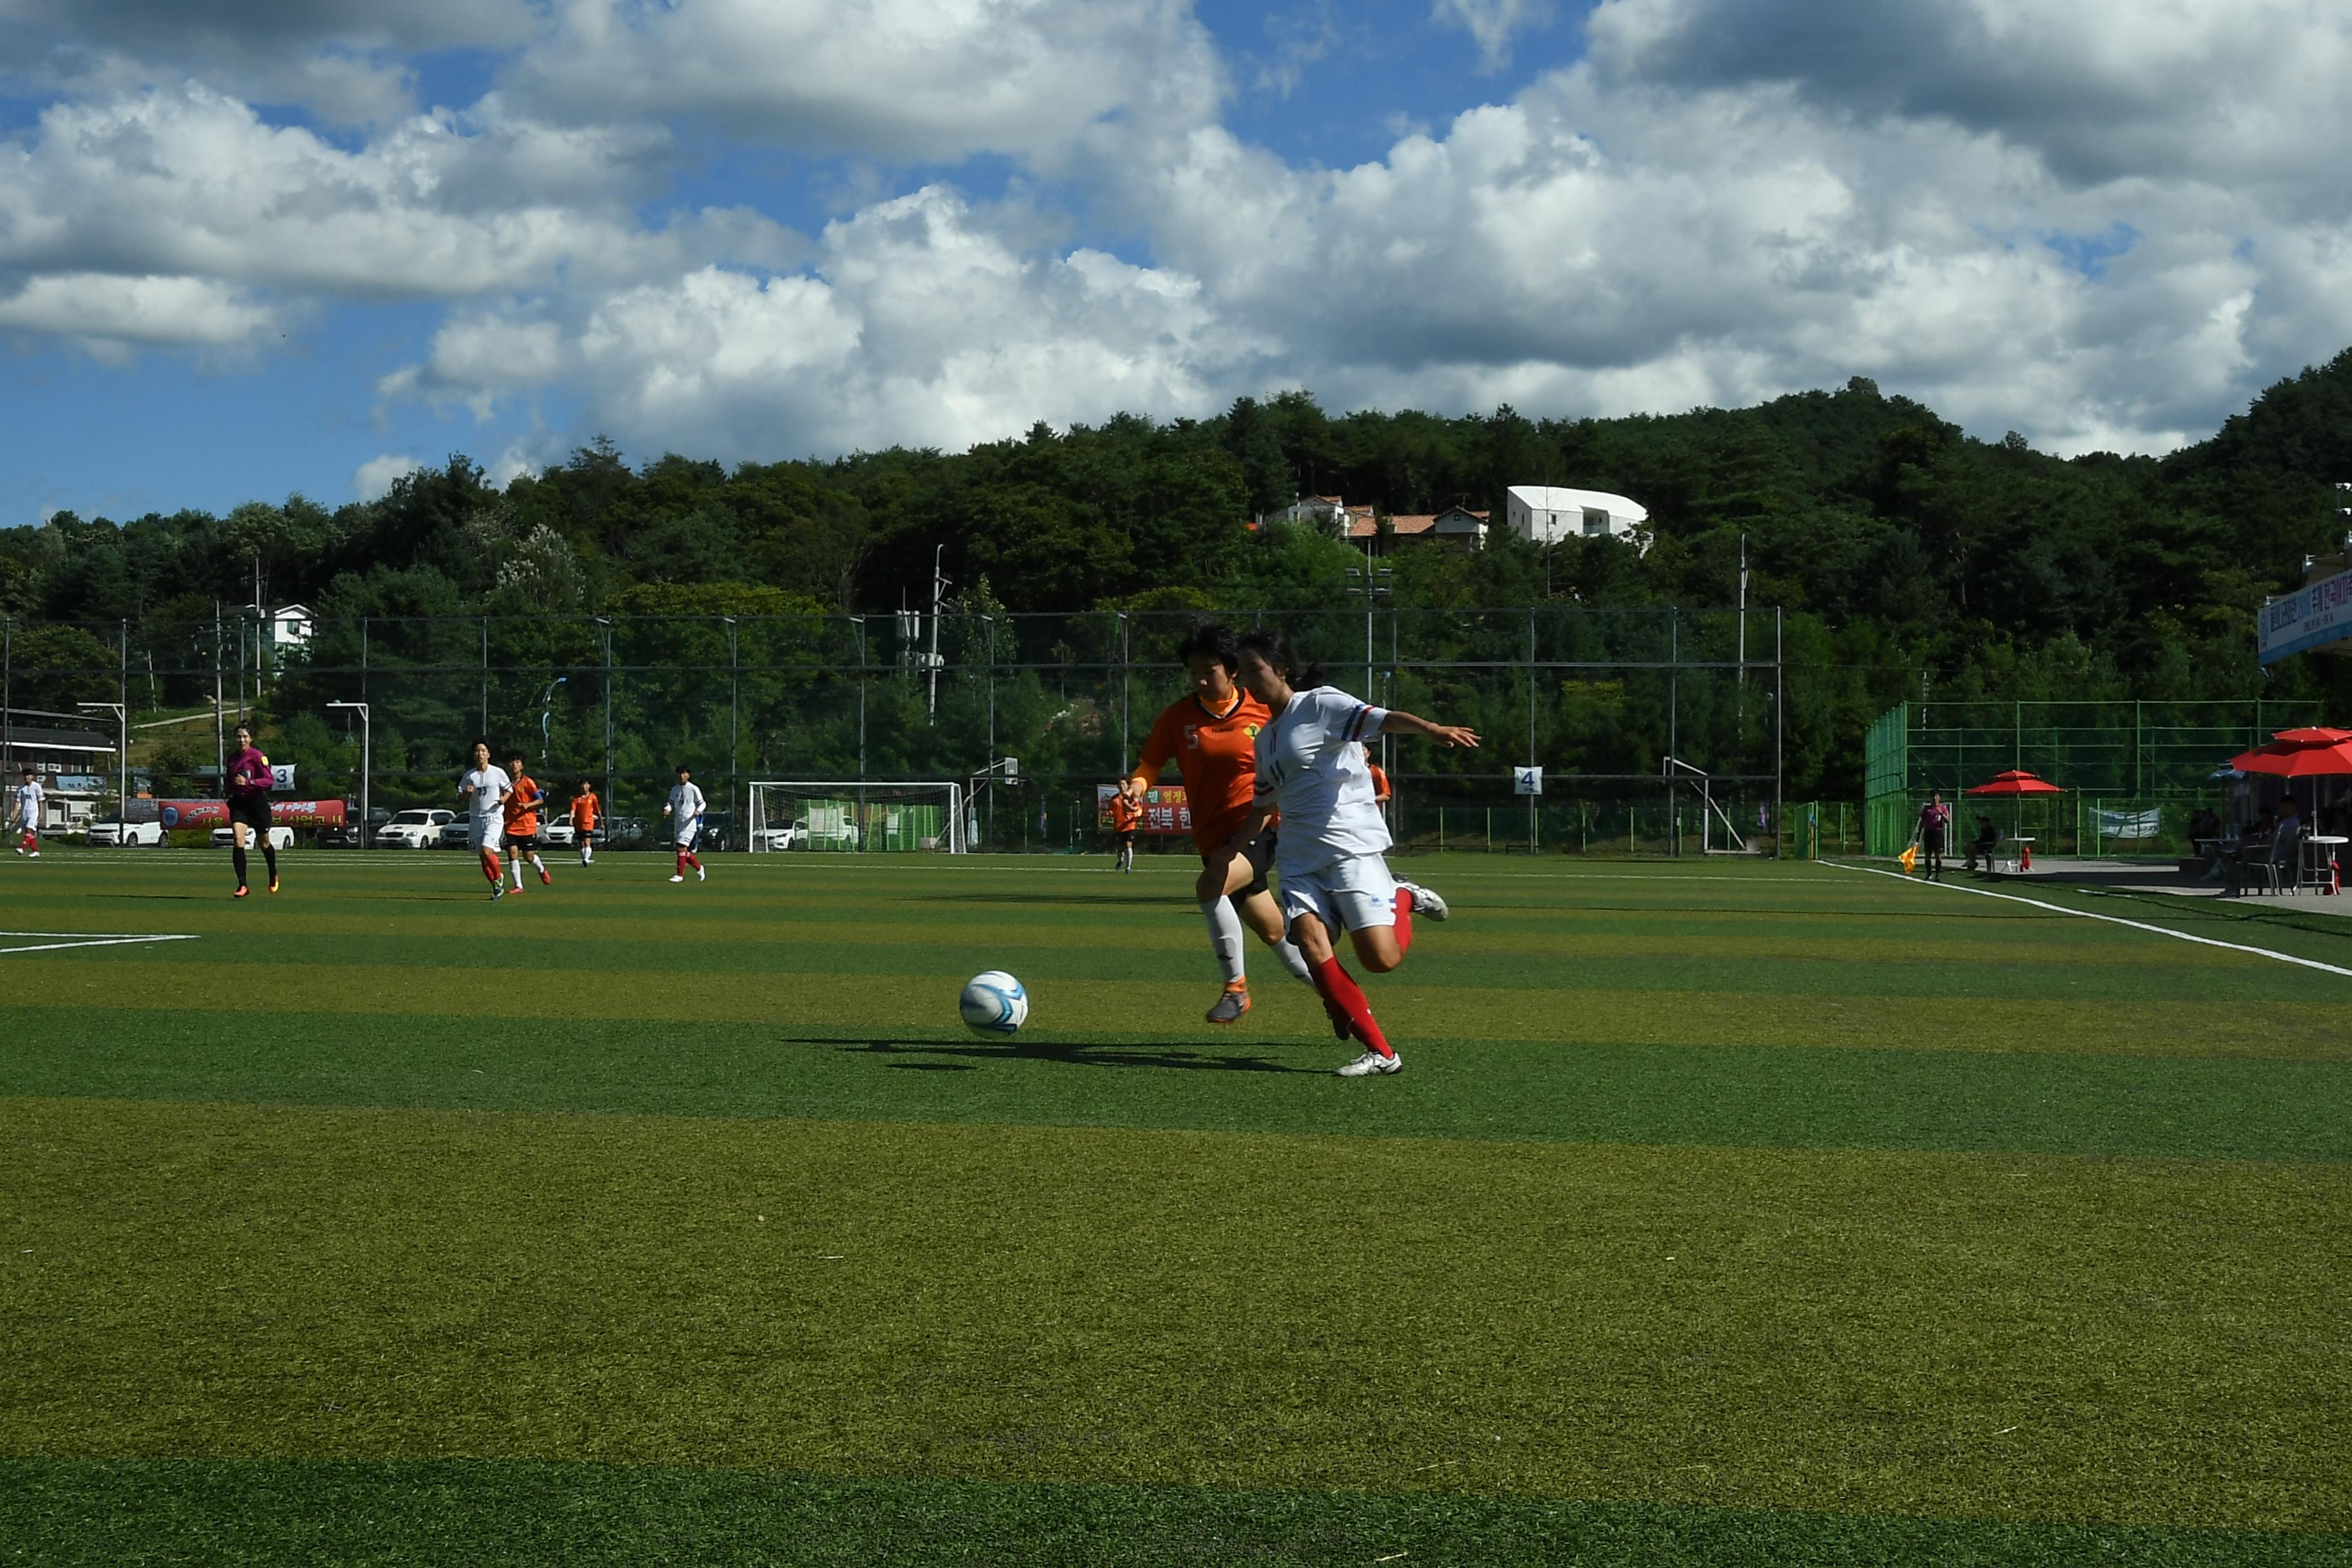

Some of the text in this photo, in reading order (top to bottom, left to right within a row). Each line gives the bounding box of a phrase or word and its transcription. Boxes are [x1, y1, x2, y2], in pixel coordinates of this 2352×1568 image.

[1184, 724, 1199, 750] 5
[277, 769, 287, 783] 3
[1521, 770, 1534, 786] 4
[1148, 807, 1174, 830] 전북
